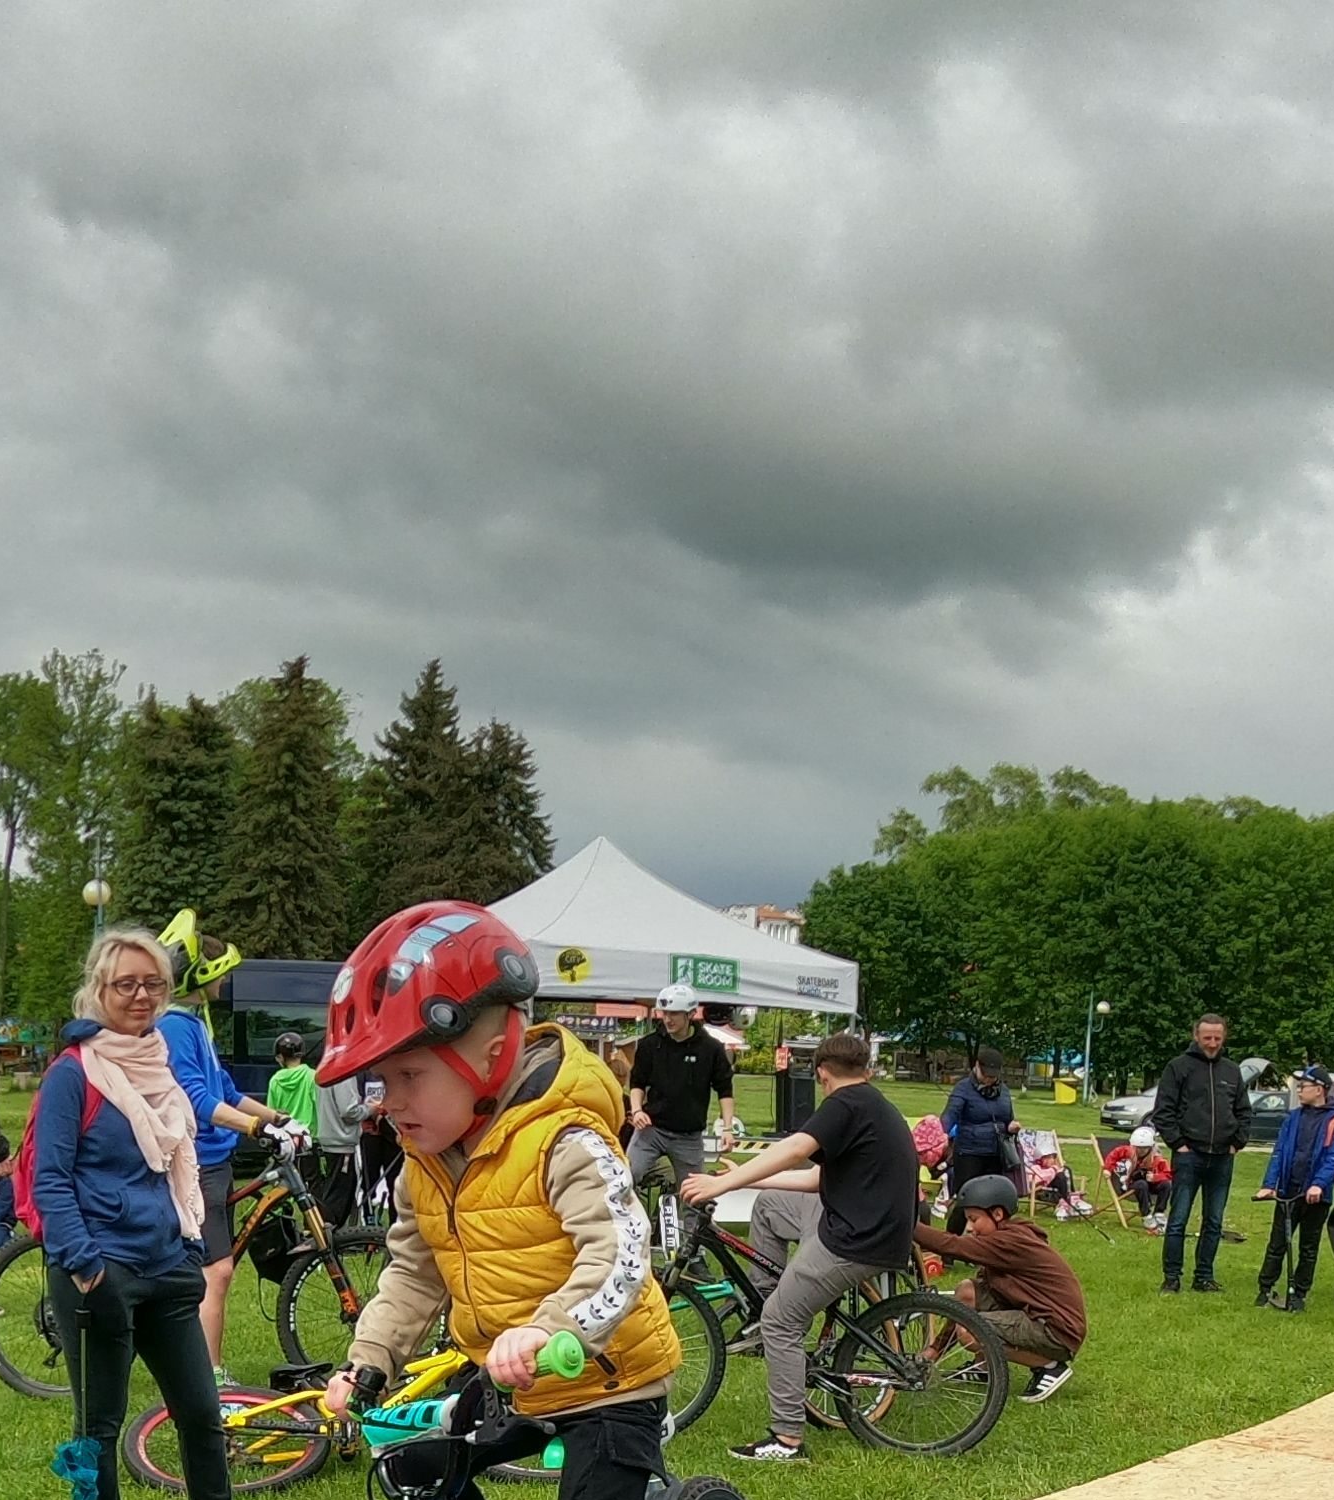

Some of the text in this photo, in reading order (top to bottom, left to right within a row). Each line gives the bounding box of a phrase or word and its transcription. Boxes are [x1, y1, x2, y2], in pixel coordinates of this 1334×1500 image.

[698, 961, 734, 976] SKATE
[697, 974, 734, 987] ROOM
[797, 975, 839, 989] SKATEBOARD
